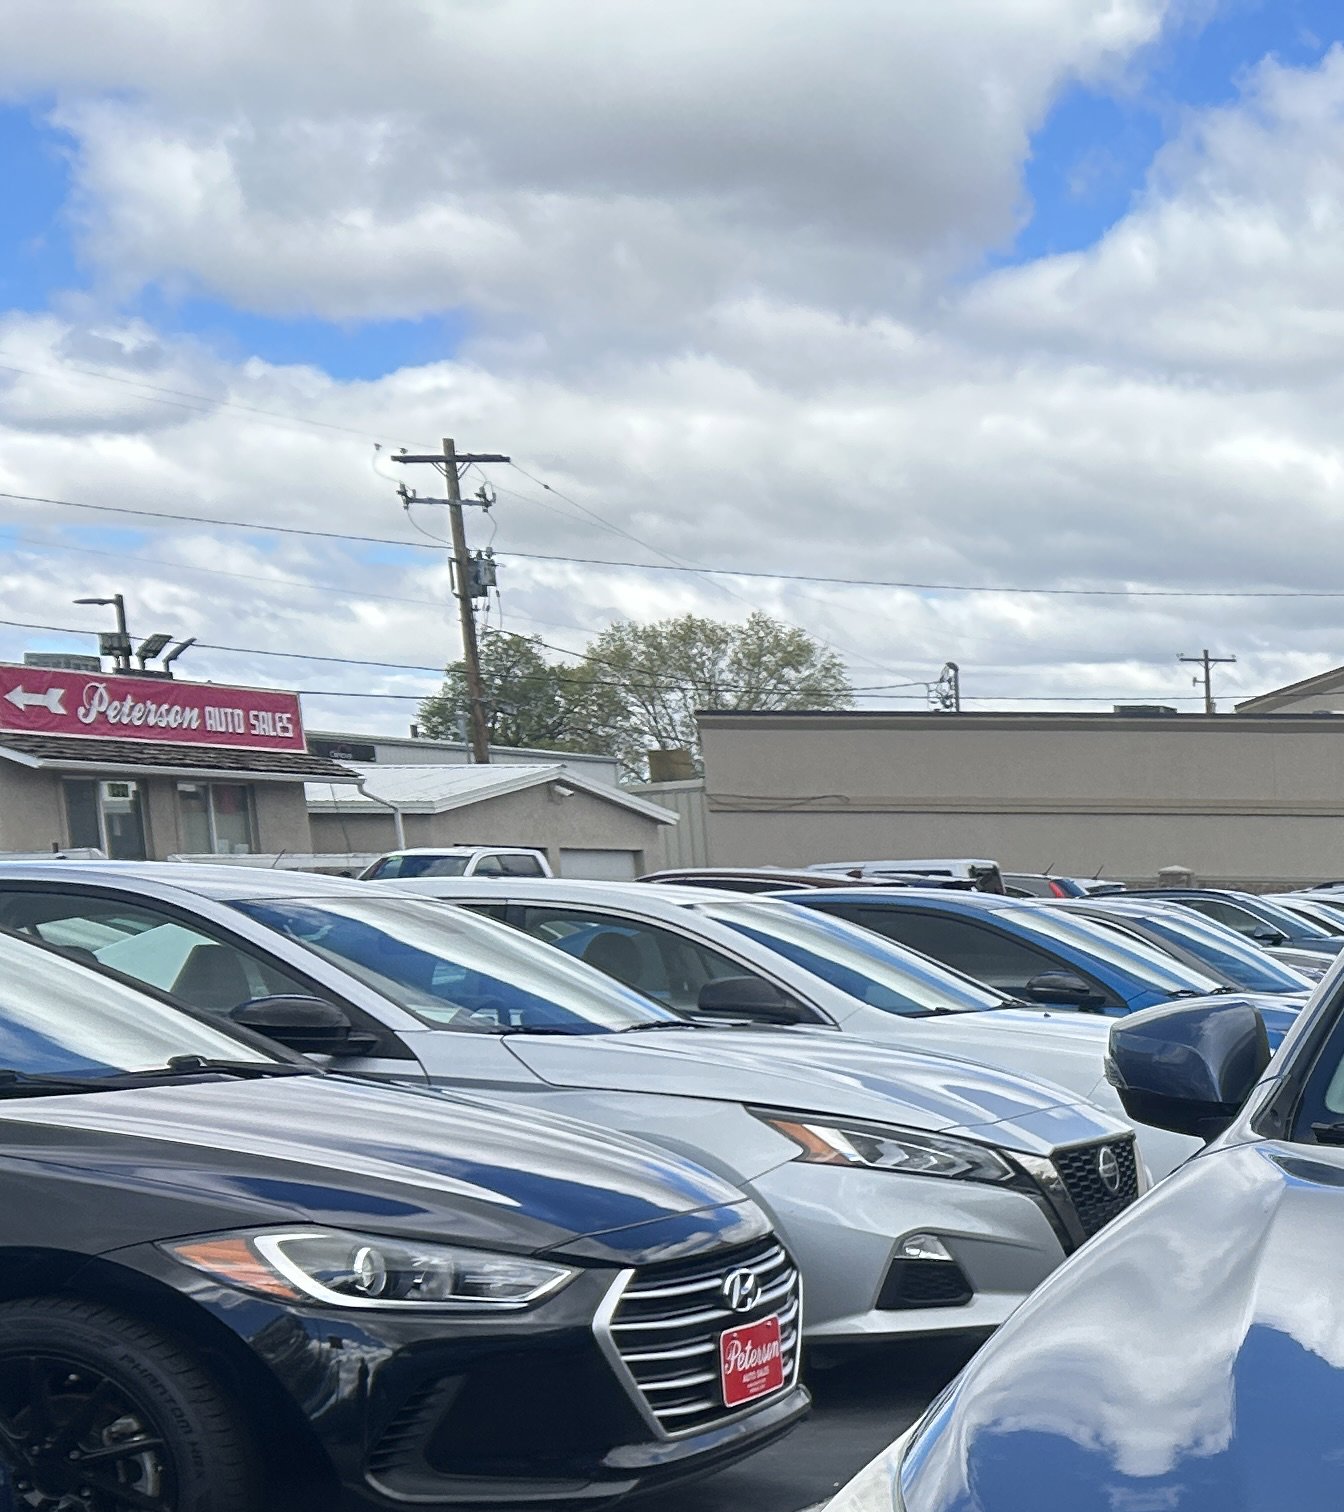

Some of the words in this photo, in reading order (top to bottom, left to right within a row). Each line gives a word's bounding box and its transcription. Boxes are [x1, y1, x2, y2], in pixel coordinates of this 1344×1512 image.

[77, 682, 201, 730] Peterson
[205, 706, 245, 734] AUTO
[250, 710, 294, 738] SALES
[725, 1340, 780, 1375] Peterson
